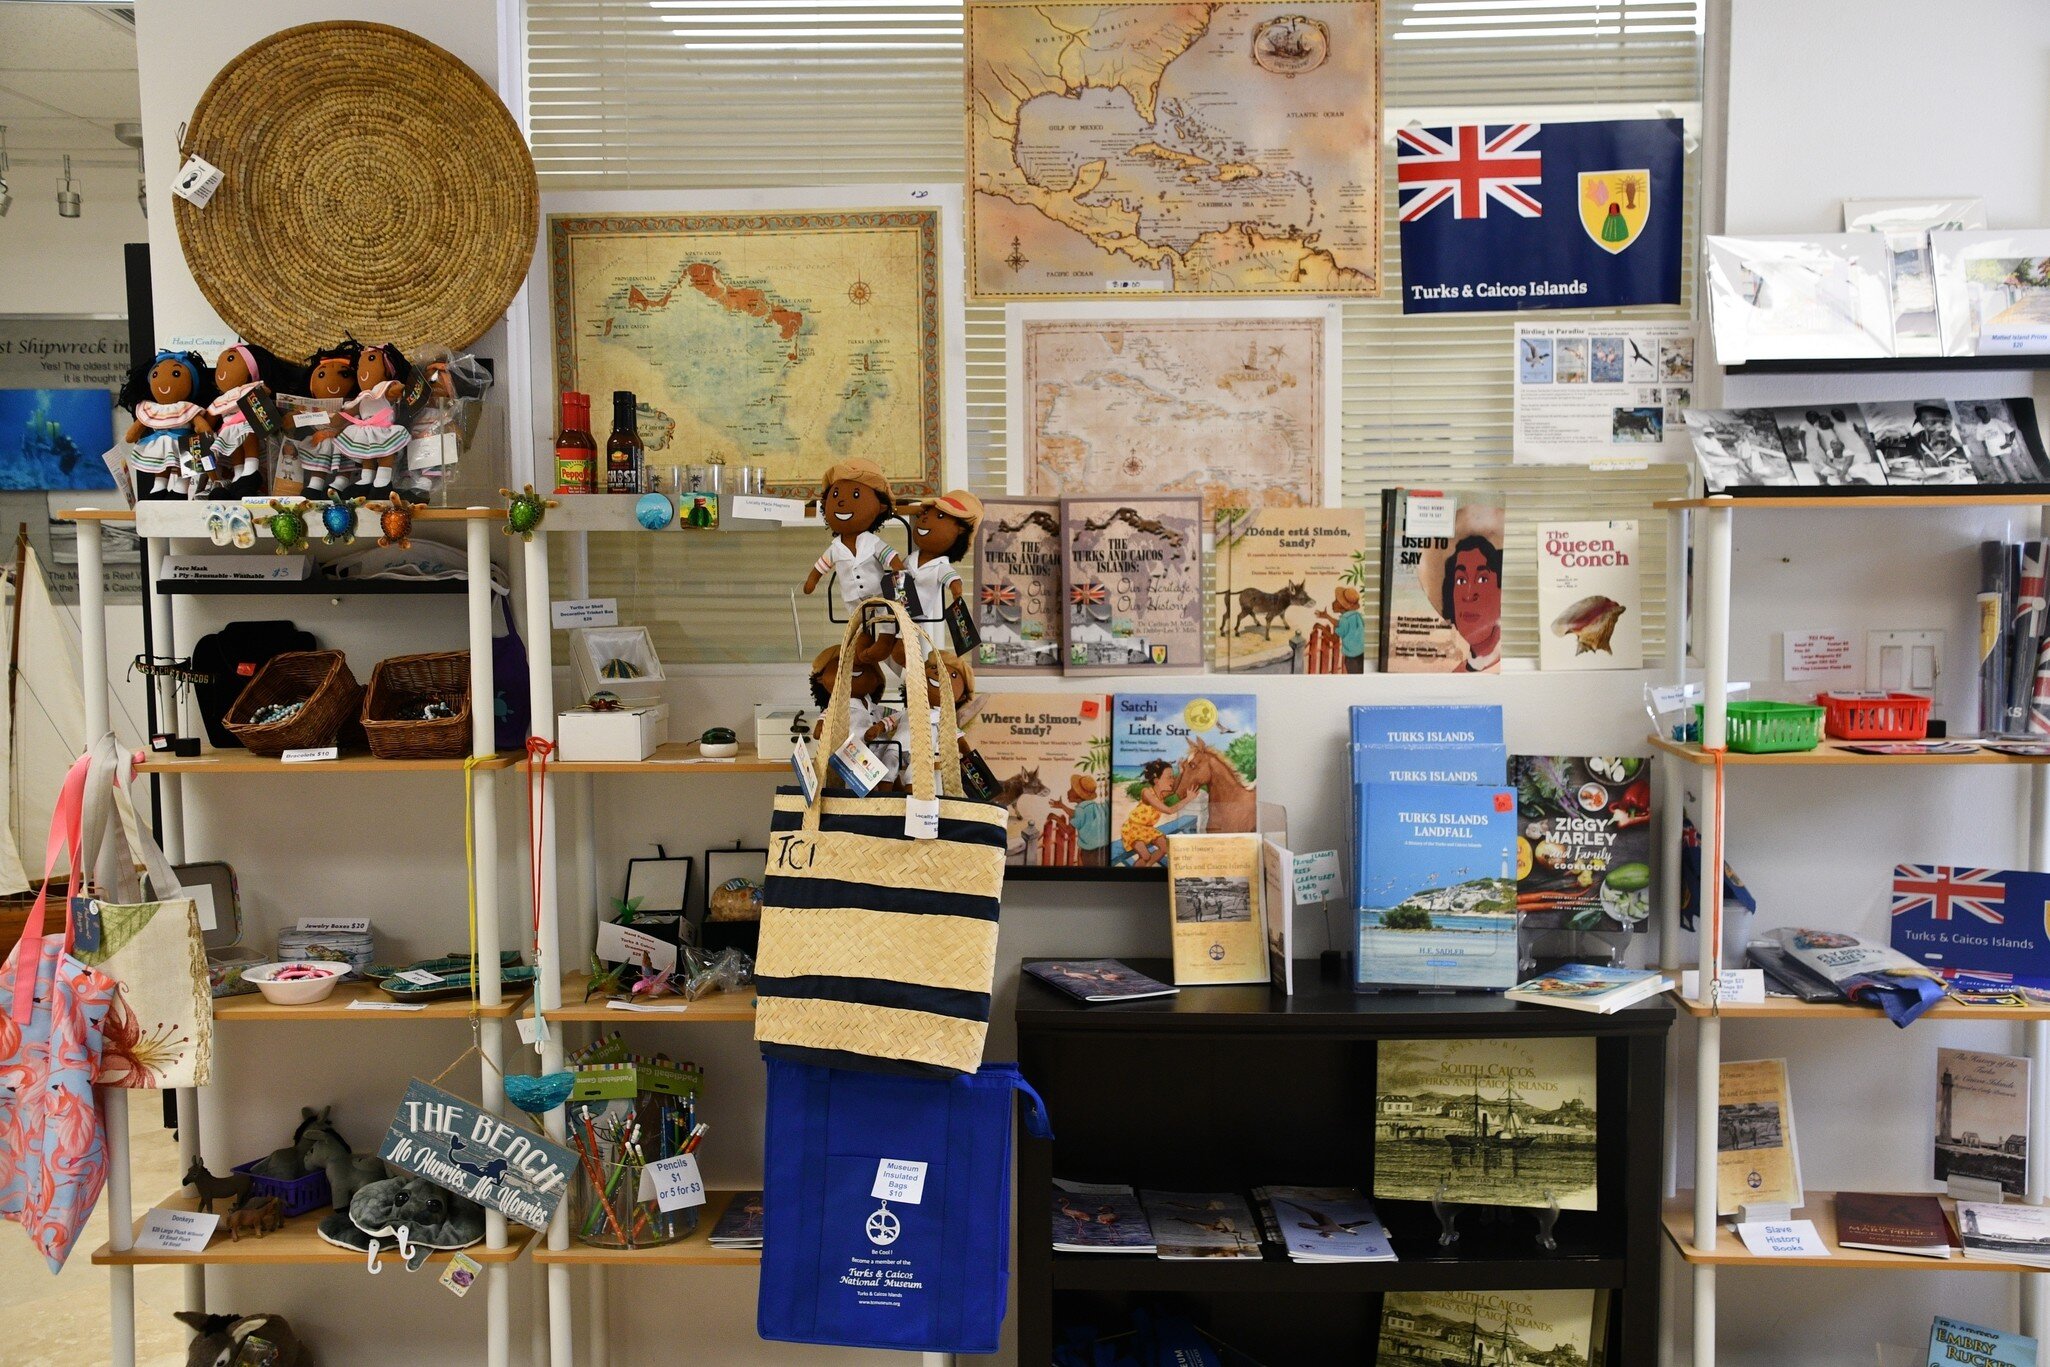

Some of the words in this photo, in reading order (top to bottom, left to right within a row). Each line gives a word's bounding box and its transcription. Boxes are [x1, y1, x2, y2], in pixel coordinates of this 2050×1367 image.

[1411, 283, 1459, 300] Turks
[1462, 284, 1473, 298] &
[1476, 282, 1527, 298] Caicos
[1529, 279, 1588, 297] Islands
[19, 337, 108, 355] Shipwreck
[195, 337, 226, 346] Crafted
[41, 361, 61, 371] Yes!
[64, 361, 80, 371] The
[83, 361, 109, 371] oldest
[64, 374, 73, 383] It
[74, 374, 80, 383] is
[83, 374, 117, 384] thought
[1288, 527, 1310, 536] está
[1546, 531, 1569, 539] The
[1021, 541, 1040, 554] THE
[1108, 538, 1128, 550] THE
[1279, 539, 1316, 549] Sandy?
[1402, 536, 1431, 549] USED
[1433, 536, 1449, 549] TO
[1545, 539, 1615, 557] Queen
[985, 551, 1017, 564] TURKS
[1021, 552, 1039, 565] AND
[1072, 550, 1105, 562] TURKS
[1106, 549, 1127, 562] AND
[1128, 549, 1164, 562] CAICOS
[1400, 551, 1422, 565] SAY
[1561, 550, 1630, 567] Conch
[1008, 563, 1051, 576] ISLANDS:
[1096, 560, 1140, 573] ISLANDS:
[1116, 577, 1141, 595] Our
[1116, 595, 1142, 613] Our
[1120, 700, 1158, 712] Satchi
[981, 713, 1022, 724] Where
[1025, 713, 1035, 724] is
[1038, 713, 1082, 726] Simon,
[1010, 725, 1052, 737] Sandy?
[1129, 724, 1162, 736] Little
[1165, 724, 1192, 736] Star
[1387, 731, 1425, 742] TURKS
[1427, 731, 1475, 742] ISLANDS
[1389, 771, 1427, 782] TURKS
[1429, 771, 1478, 782] ISLANDS
[1398, 812, 1437, 824] TURKS
[1439, 813, 1489, 826] ISLANDS
[1555, 817, 1608, 832] ZIGGY
[1414, 826, 1473, 838] LANDFALL
[1545, 831, 1617, 846] MARLEY
[778, 834, 816, 870] TCI
[1574, 845, 1613, 865] Family
[1553, 862, 1607, 871] COOKBOOK
[1905, 930, 1936, 942] Turks
[1939, 932, 1948, 942] &
[1952, 933, 1989, 946] Caicos
[1992, 938, 2034, 950] Islands
[1436, 948, 1465, 956] SADLER
[1440, 1061, 1484, 1075] SOUTH
[1487, 1062, 1537, 1079] CAICOS,
[1453, 1078, 1476, 1087] AND
[1478, 1079, 1516, 1089] CAICOS
[1518, 1081, 1559, 1091] ISLANDS
[405, 1100, 464, 1136] THE
[471, 1114, 565, 1194] BEACH
[656, 1159, 688, 1172] Pencils
[887, 1163, 919, 1173] Museum
[386, 1137, 412, 1163] No
[413, 1146, 468, 1192] Hurries,
[467, 1175, 493, 1200] No
[498, 1185, 549, 1227] Worries
[671, 1172, 682, 1182] $1
[883, 1171, 919, 1182] Insulated
[659, 1190, 669, 1198] or
[670, 1187, 676, 1197] 5
[677, 1185, 689, 1195] for
[690, 1181, 701, 1193] $3
[888, 1181, 908, 1190] Bags
[888, 1190, 903, 1198] $10
[171, 1214, 195, 1224] Donkeys
[161, 1227, 174, 1235] Large
[1765, 1226, 1792, 1234] Slave
[1765, 1235, 1801, 1244] History
[848, 1267, 874, 1278] Turks
[875, 1270, 884, 1278] &
[885, 1270, 914, 1280] Caicos
[839, 1275, 881, 1287] National
[883, 1279, 923, 1290] Museum
[1443, 1290, 1485, 1306] SOUTH
[1515, 1316, 1554, 1334] ISLANDS
[1936, 1327, 1997, 1356] EMBRY
